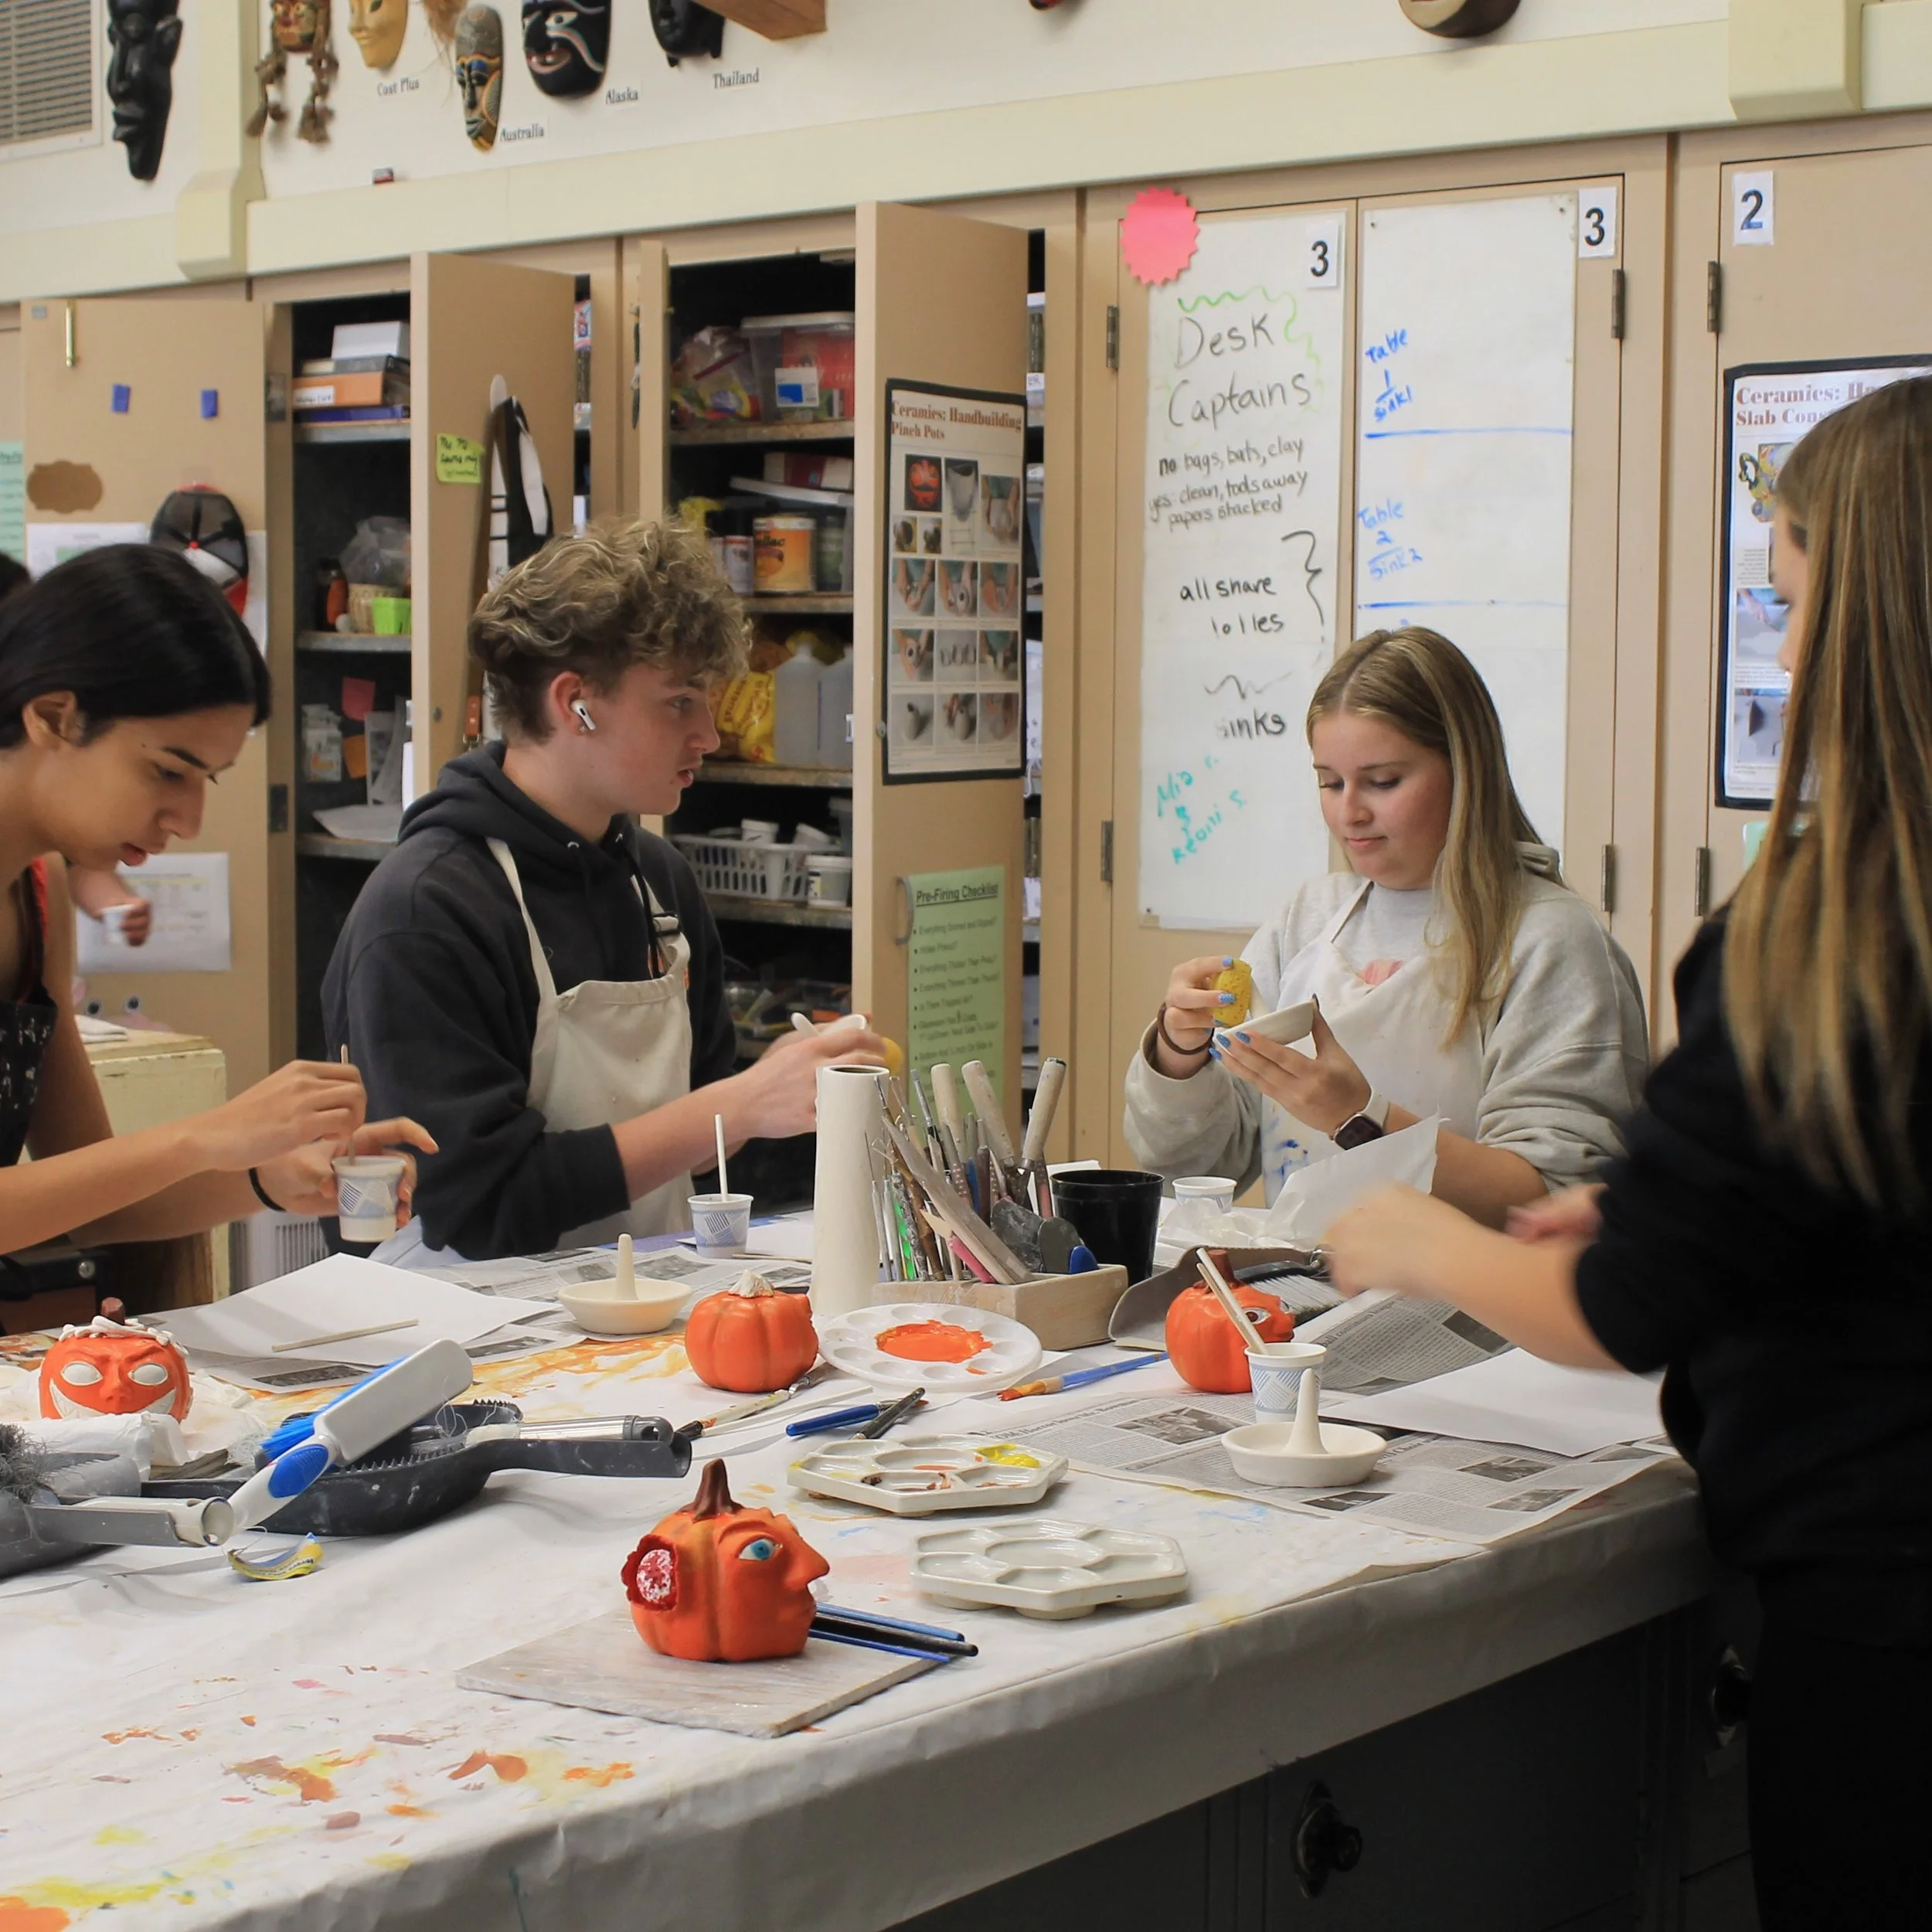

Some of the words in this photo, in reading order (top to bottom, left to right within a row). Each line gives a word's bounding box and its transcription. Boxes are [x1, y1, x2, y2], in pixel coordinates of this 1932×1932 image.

[400, 77, 420, 93] Plus
[713, 67, 760, 89] Thailand
[605, 87, 639, 105] Alaska
[499, 123, 545, 142] Australia
[1740, 188, 1764, 230] 2
[1585, 207, 1606, 247] 3
[1310, 240, 1329, 277] 3
[1168, 370, 1311, 430] Captains
[1736, 384, 1840, 405] Ceramics:
[892, 399, 946, 422] Ceramics:
[949, 406, 1022, 431] Handbuilding
[1736, 408, 1776, 426] Slab
[891, 421, 921, 438] Pinch
[923, 423, 945, 440] Pots
[1158, 457, 1176, 477] no
[1267, 435, 1303, 463] clay
[1262, 470, 1308, 497] away
[1168, 506, 1213, 533] papers
[1217, 494, 1283, 519] stacked
[1179, 577, 1210, 602] all
[917, 887, 960, 904] Pre-Firing
[961, 883, 998, 899] Checklist
